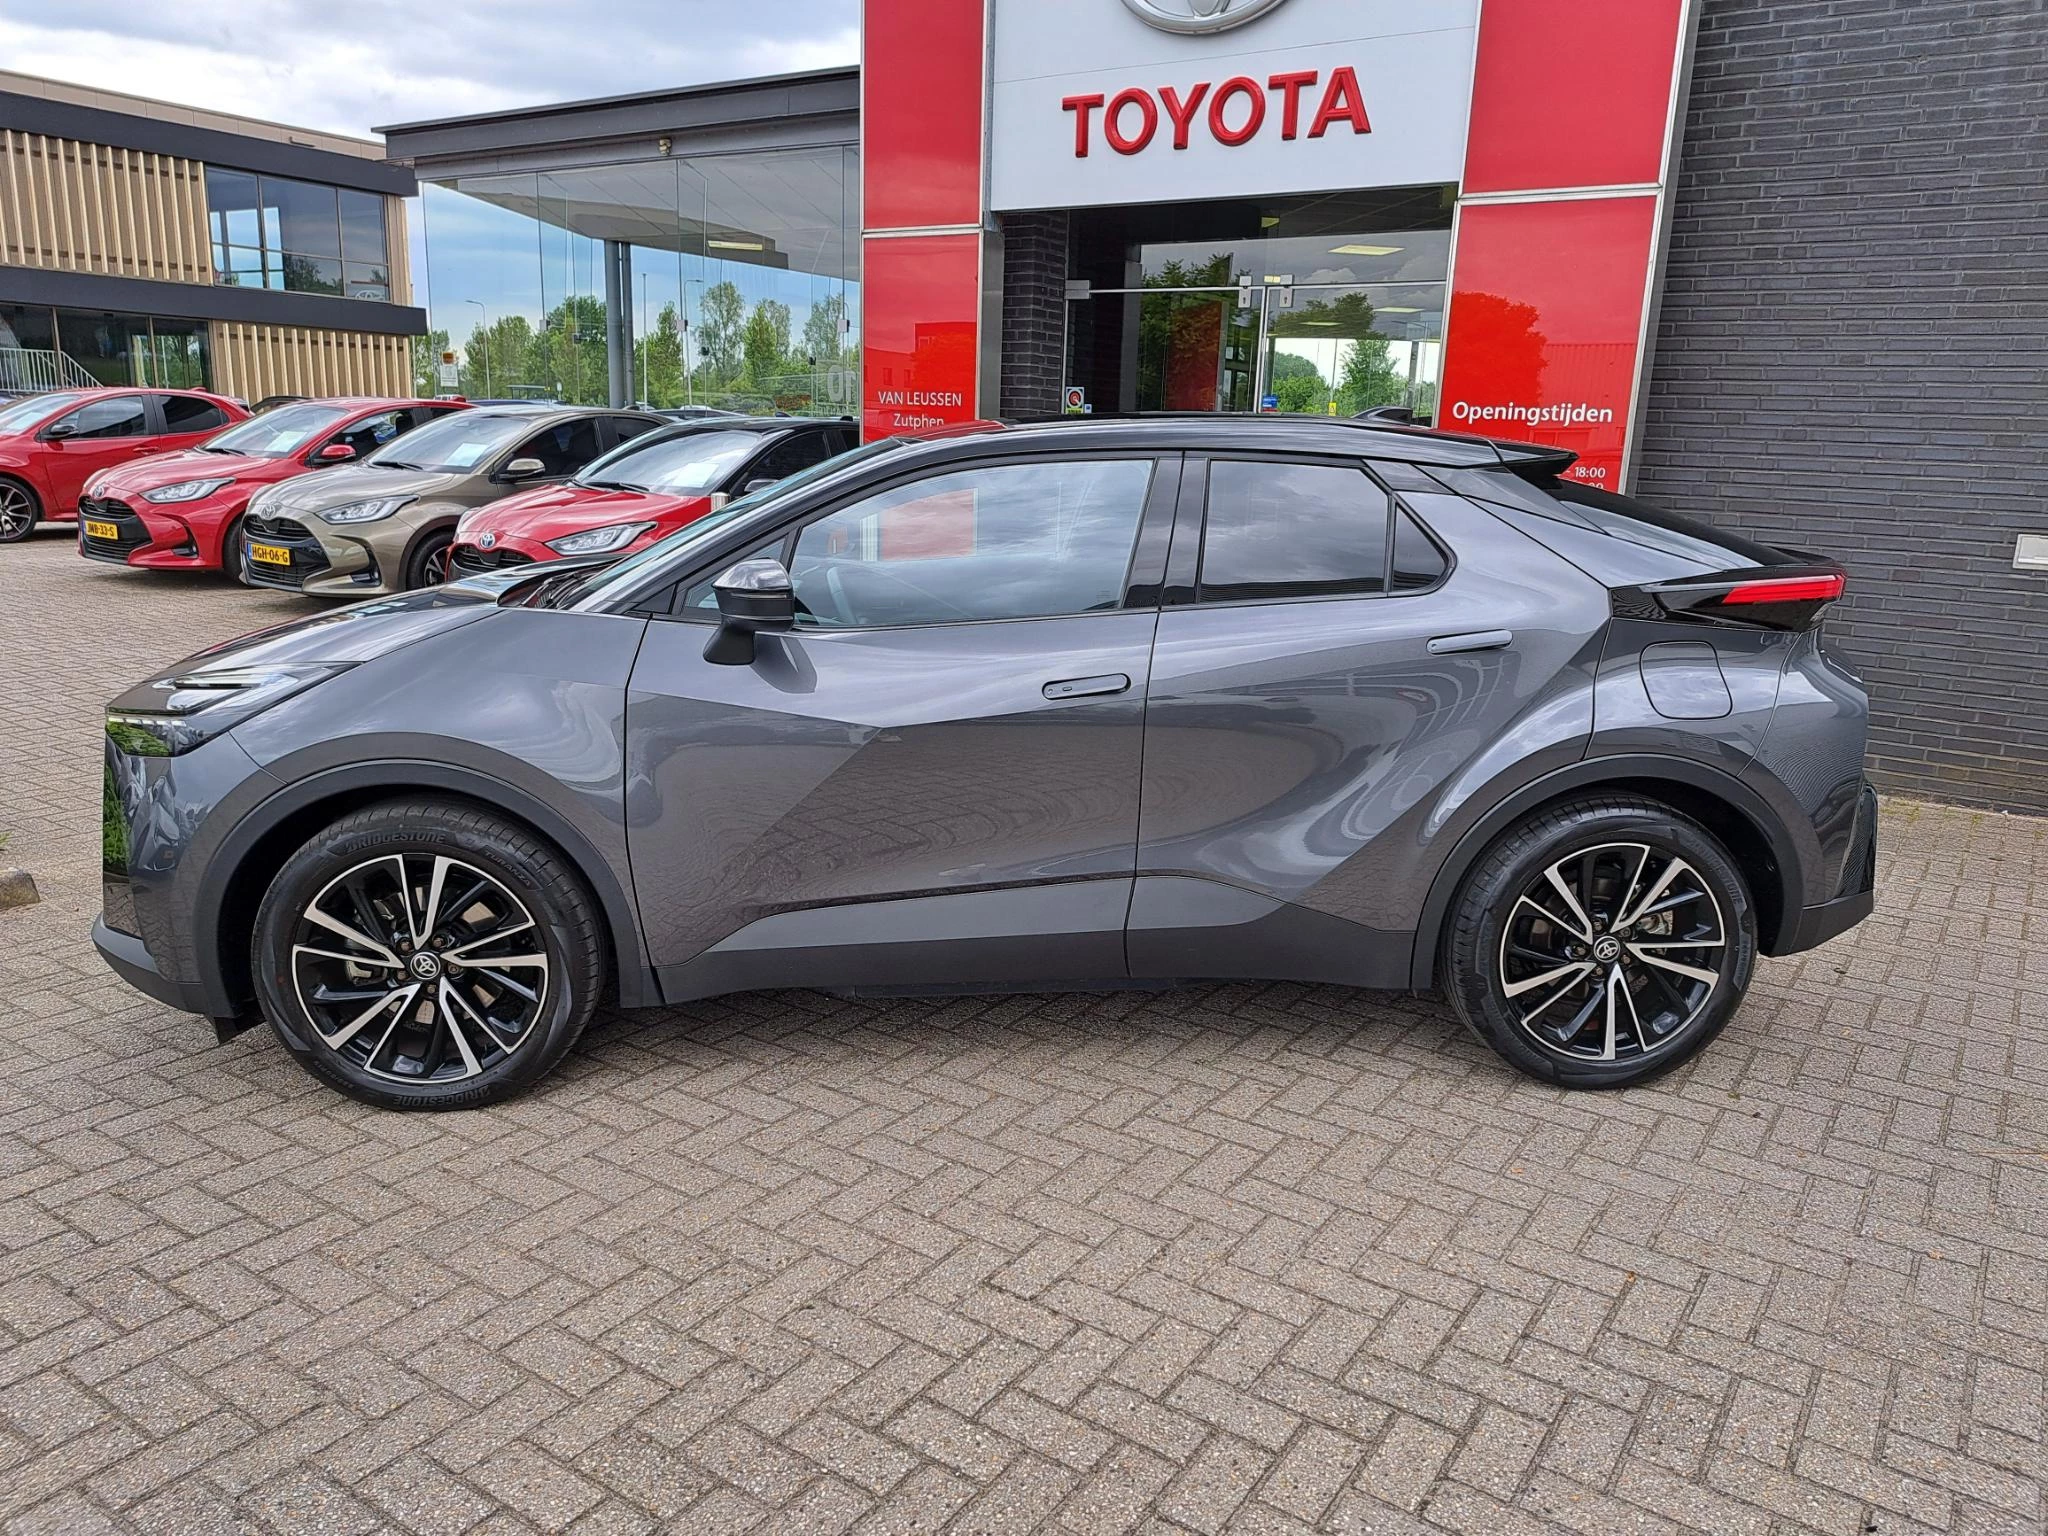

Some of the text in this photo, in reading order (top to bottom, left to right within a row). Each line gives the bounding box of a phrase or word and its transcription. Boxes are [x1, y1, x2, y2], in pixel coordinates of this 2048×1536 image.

[1062, 66, 1371, 158] TOYOTA
[878, 391, 962, 407] VAN LEUSSEN
[893, 413, 944, 430] Zutphen
[1452, 401, 1613, 427] Openingstijden
[1574, 466, 1606, 479] 18:00
[345, 831, 446, 853] BRIDGESTONE
[484, 849, 530, 887] TURANZA
[393, 1085, 490, 1106] BRIDGESTONE
